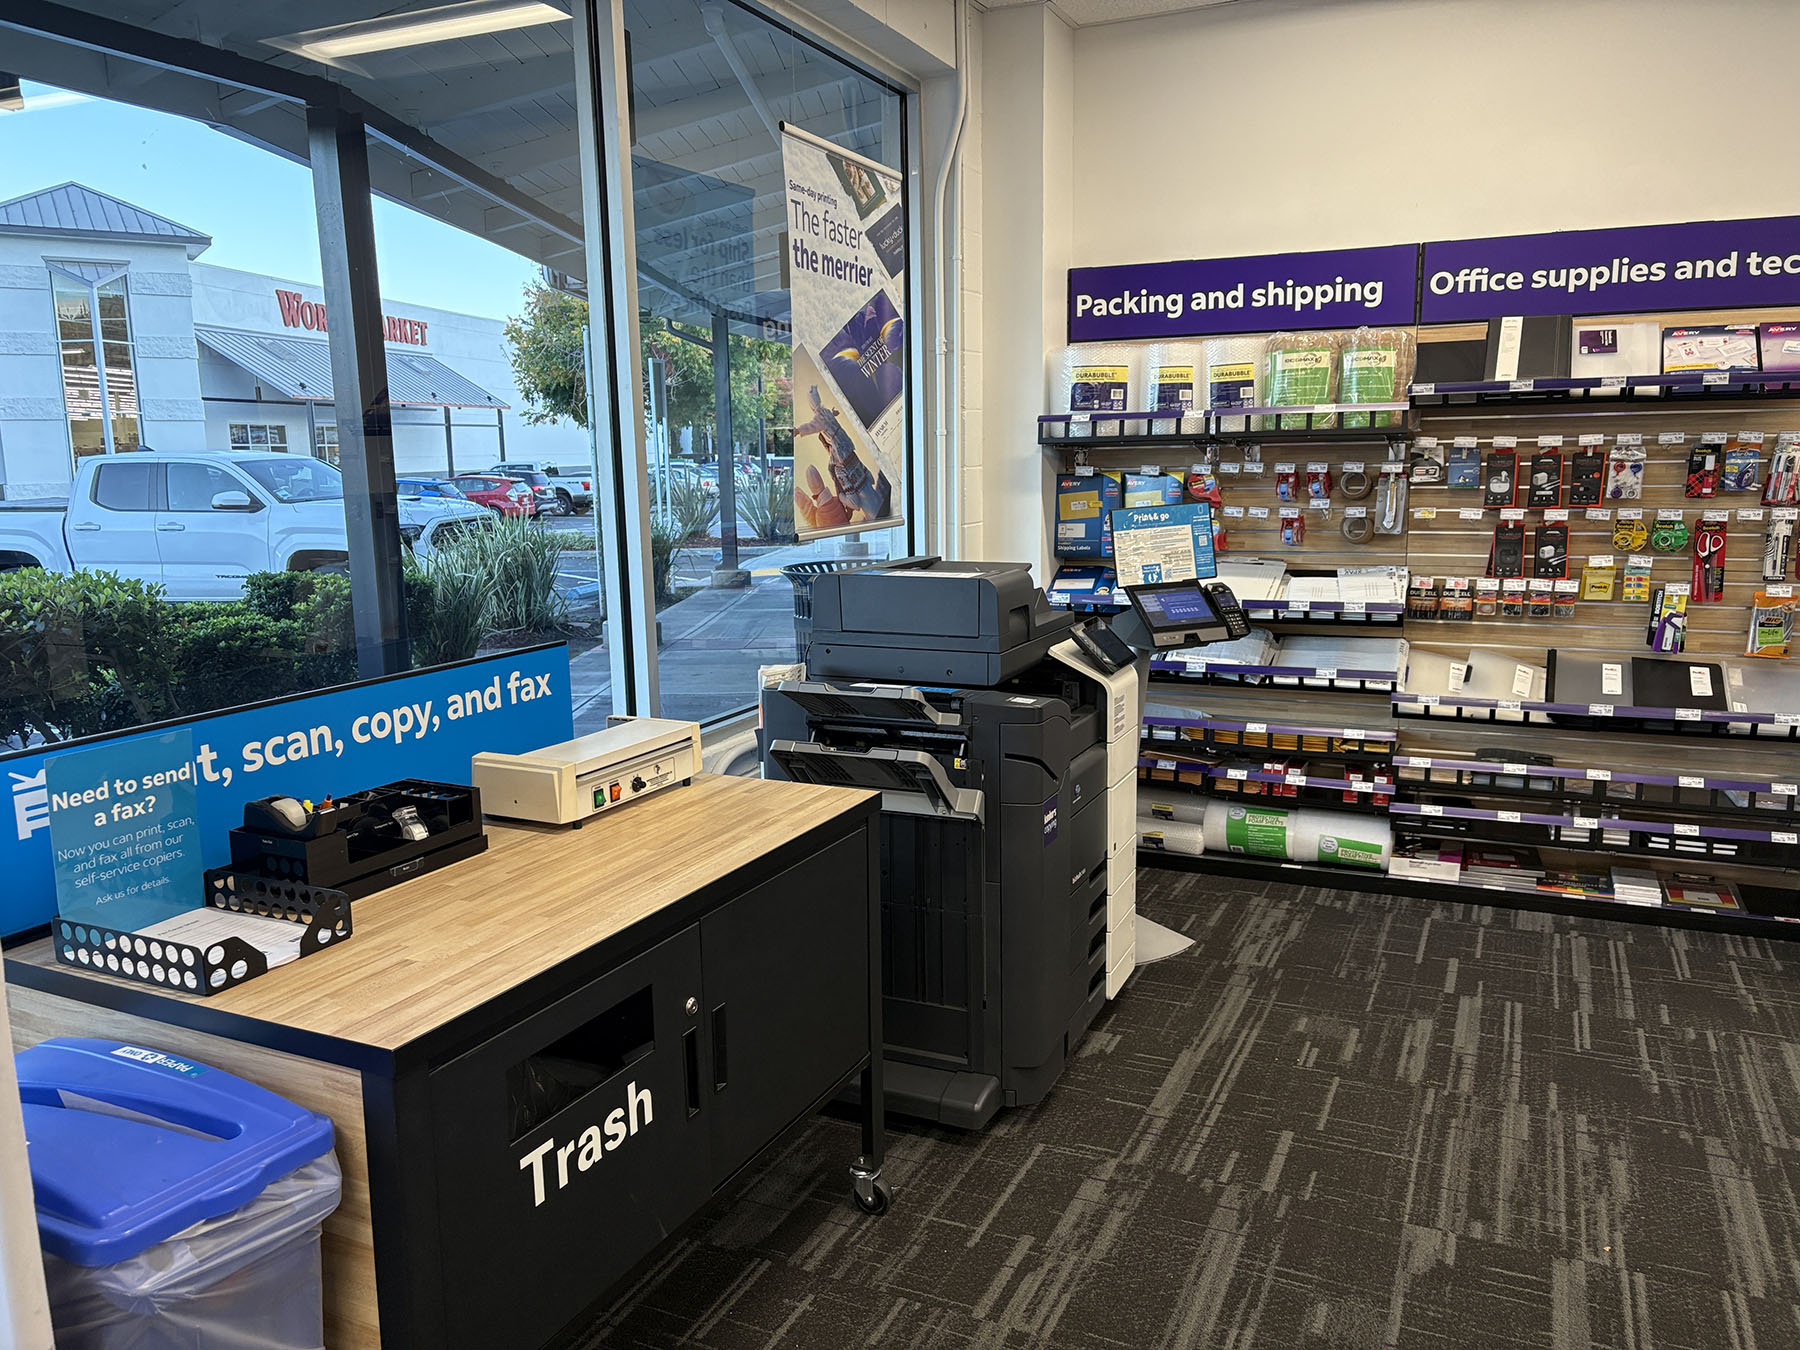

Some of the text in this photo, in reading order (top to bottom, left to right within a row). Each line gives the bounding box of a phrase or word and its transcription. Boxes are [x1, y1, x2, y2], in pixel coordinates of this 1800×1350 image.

[789, 180, 838, 210] Same-day printing
[790, 198, 820, 236] The
[823, 210, 862, 250] faster
[792, 238, 873, 287] the merrier
[1429, 267, 1524, 296] Office
[1530, 257, 1666, 293] supplies
[1674, 251, 1739, 280] and
[275, 289, 428, 346] WOR ARKET
[1076, 276, 1384, 319] Packing and shipping
[1768, 326, 1797, 334] AVERY
[860, 344, 892, 379] WINTER
[1160, 513, 1170, 521] go
[243, 725, 344, 774] scan,
[352, 699, 441, 745] copy,
[446, 677, 502, 721] and
[508, 670, 552, 706] fax
[52, 762, 190, 812] Need to send
[94, 796, 157, 827] a fax?
[58, 816, 195, 862] Now you can print, scan,
[74, 834, 184, 873] and fax all from our
[75, 851, 184, 889] self-service copiers.
[96, 876, 170, 906] Ask us for details.
[120, 1048, 194, 1072] PAPER ONLY
[518, 1079, 654, 1208] Trash
